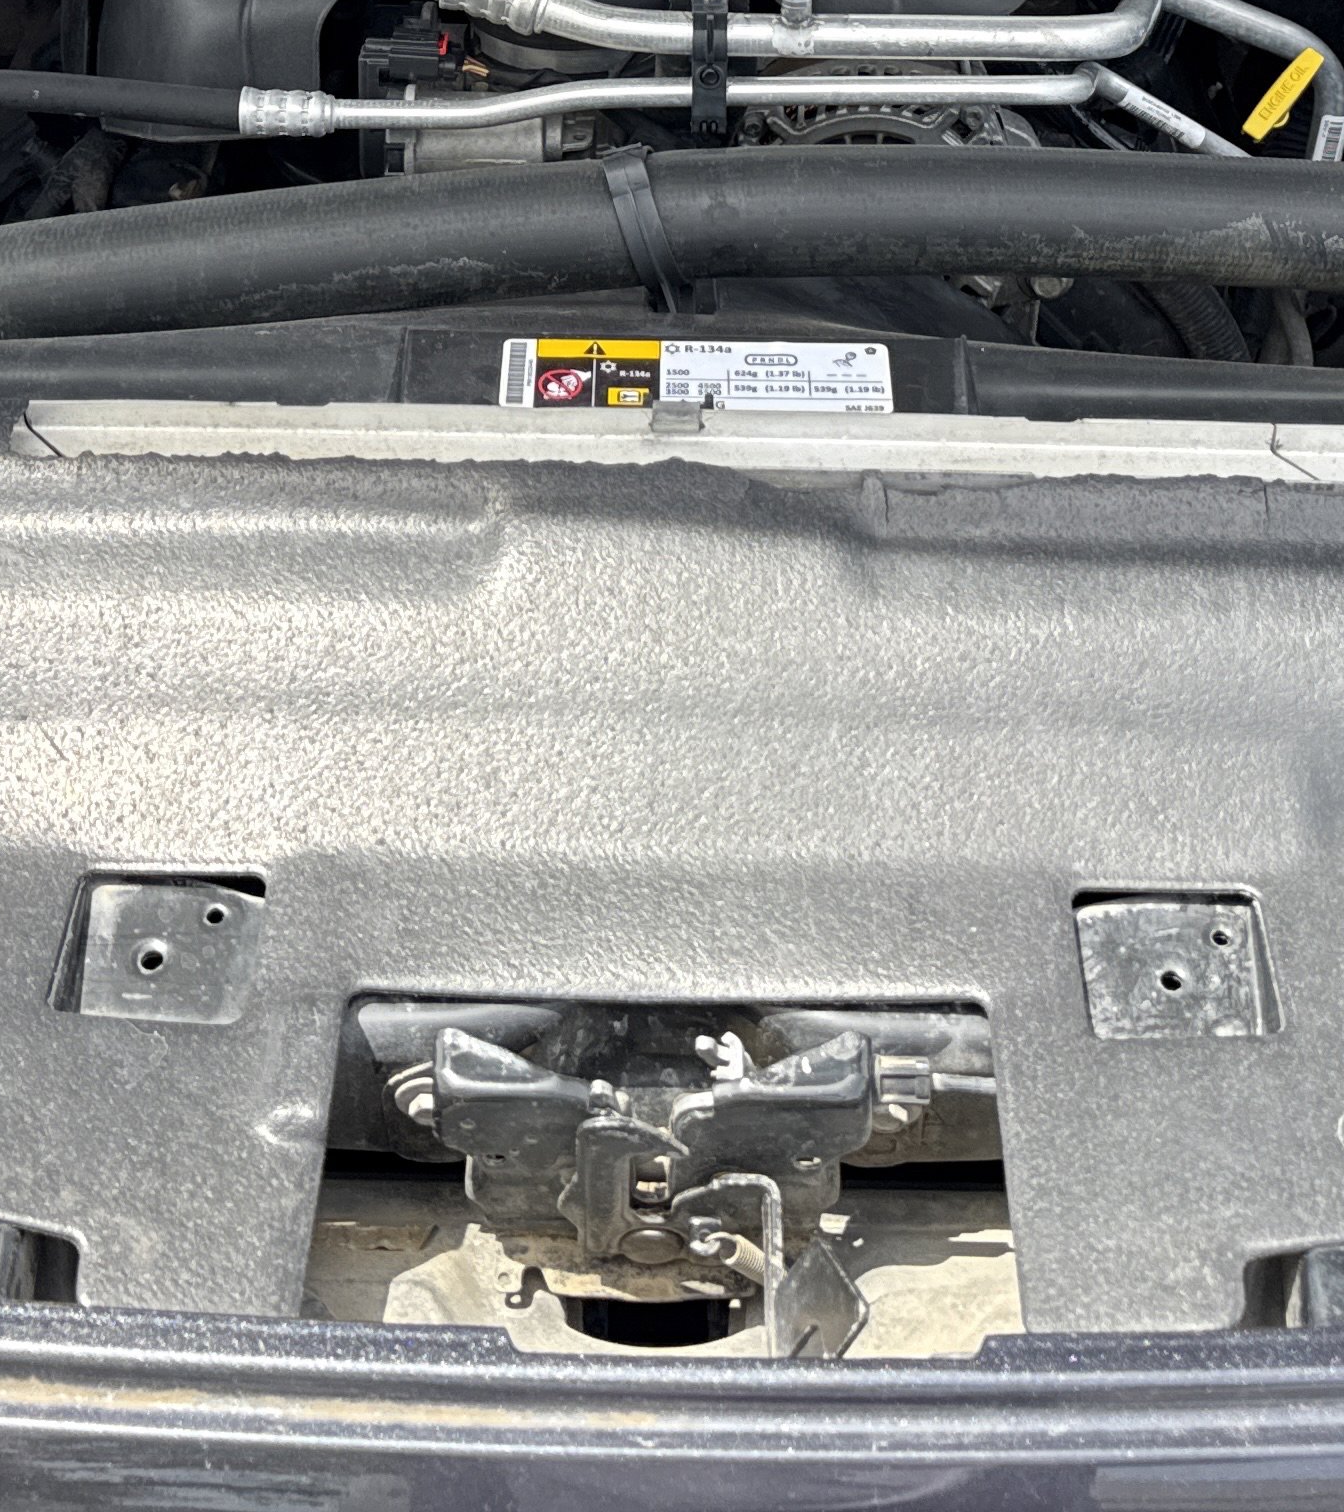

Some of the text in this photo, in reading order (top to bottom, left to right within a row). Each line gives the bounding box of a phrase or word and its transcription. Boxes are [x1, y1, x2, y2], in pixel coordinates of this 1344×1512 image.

[1257, 65, 1310, 121] ENGINE OIL
[684, 344, 732, 354] R-134a
[734, 369, 758, 378] 624g
